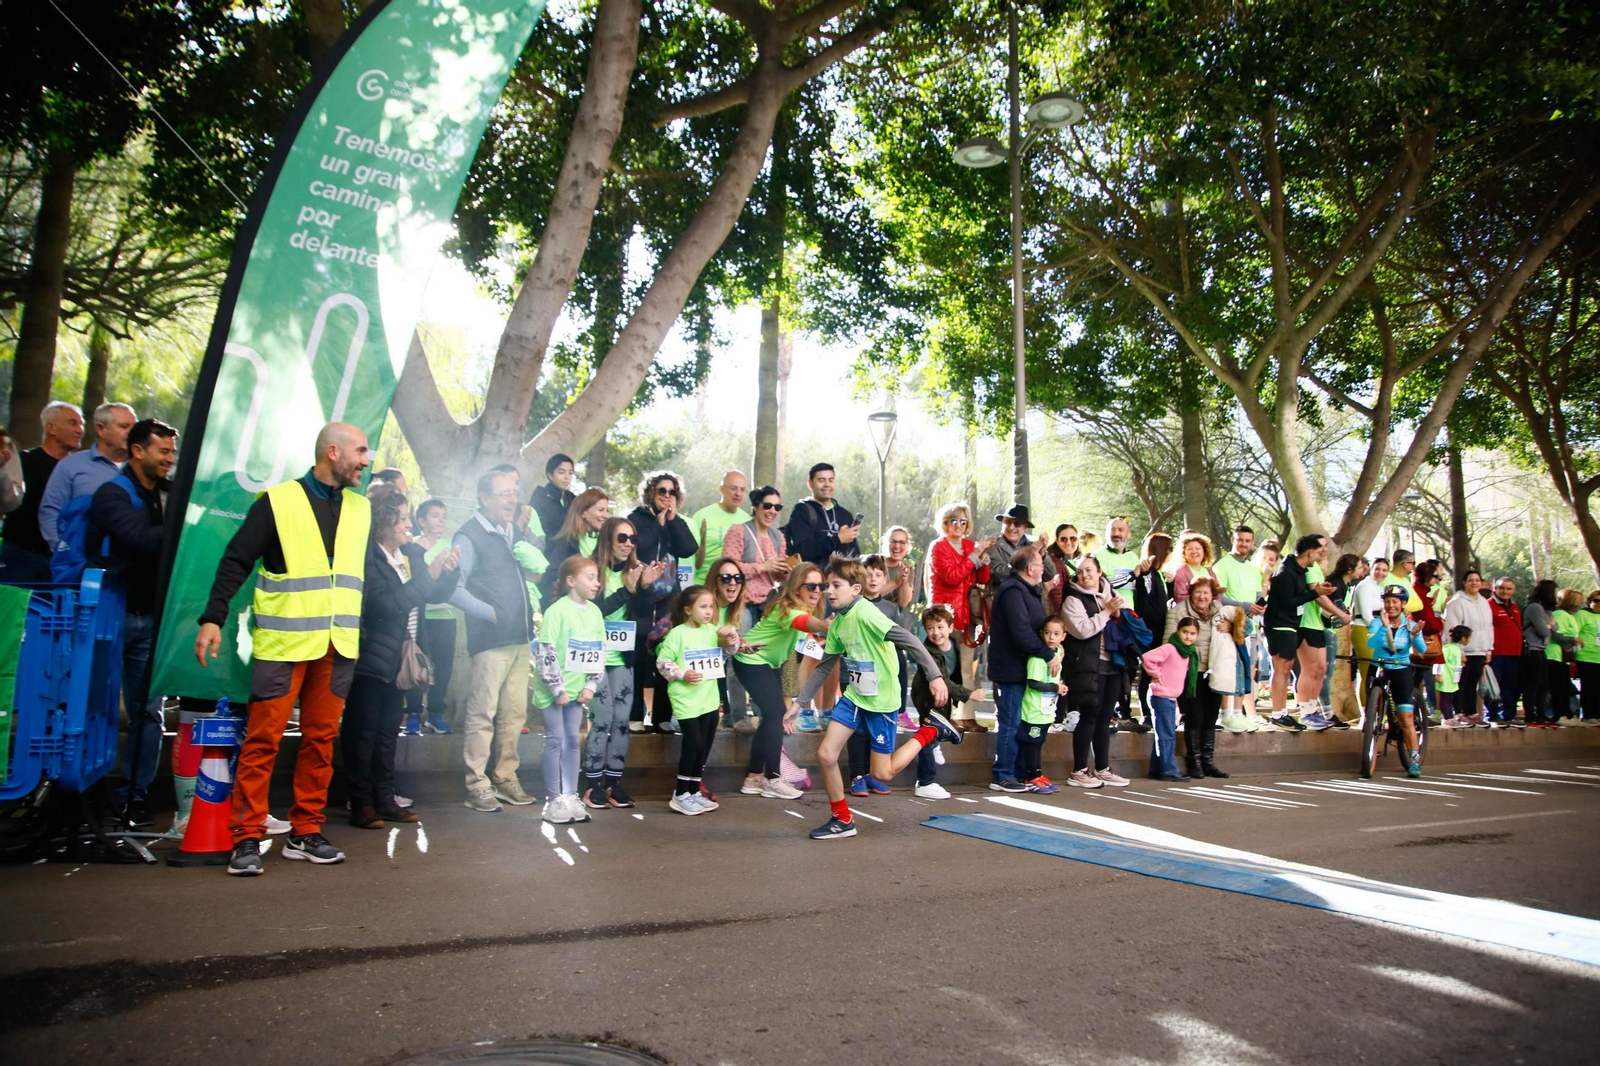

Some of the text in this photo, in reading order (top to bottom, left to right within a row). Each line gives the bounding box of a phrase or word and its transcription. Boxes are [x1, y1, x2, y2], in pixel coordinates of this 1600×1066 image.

[334, 125, 438, 171] Tenemos
[320, 153, 350, 175] un
[296, 205, 341, 228] por
[289, 229, 380, 269] delante
[570, 650, 600, 663] 1129
[689, 658, 720, 670] 1116
